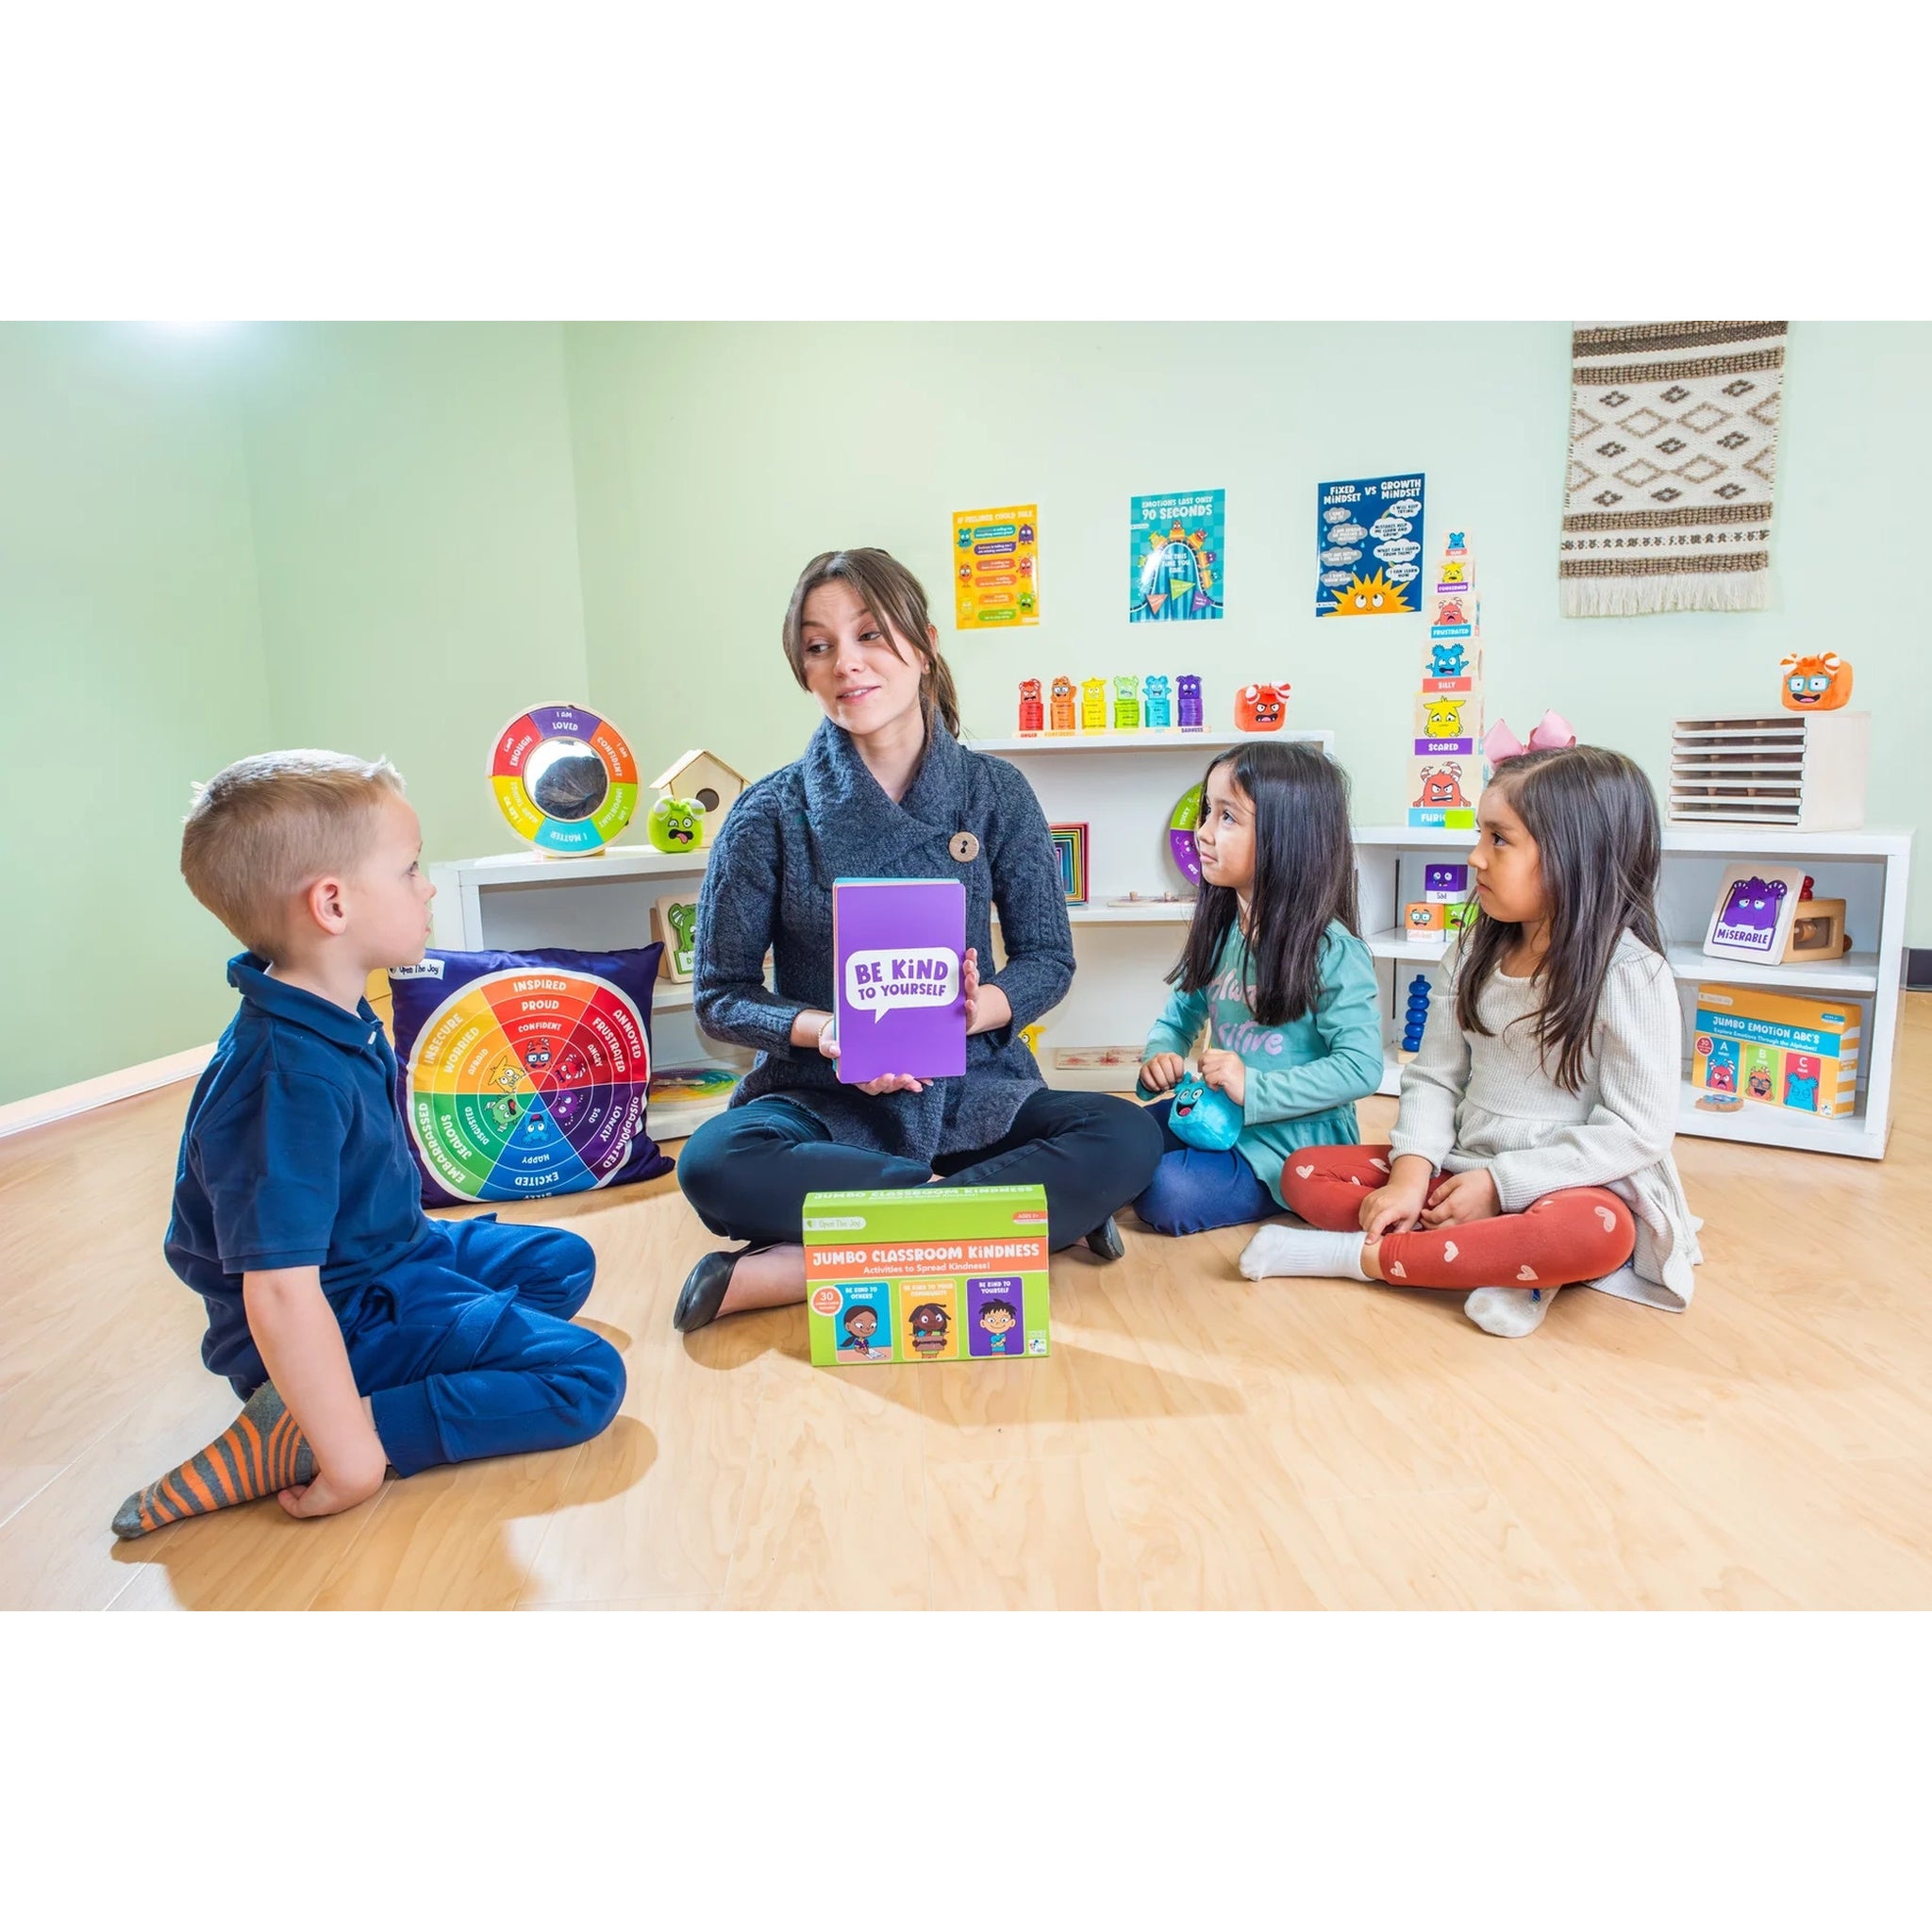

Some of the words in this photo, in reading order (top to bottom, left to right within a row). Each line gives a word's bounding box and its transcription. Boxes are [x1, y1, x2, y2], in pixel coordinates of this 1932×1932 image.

[1364, 487, 1376, 495] VS
[1381, 479, 1421, 491] GROWTH
[1142, 509, 1157, 520] 90
[1159, 504, 1213, 520] SECONDS
[1433, 627, 1469, 636] FRUSTRATED
[552, 722, 578, 731] LOVED
[509, 735, 533, 767] ENOUGH
[1428, 743, 1458, 752] SCARED
[596, 736, 623, 777] CONFIDENT
[599, 788, 623, 828] IMPORTANT
[550, 831, 582, 842] MATTER
[427, 964, 439, 975] Joy
[855, 961, 883, 985] BE
[891, 958, 948, 981] KiND
[512, 979, 567, 992] INSPIRED
[858, 987, 876, 1001] TO
[880, 983, 946, 997] YOURSELF
[521, 1000, 559, 1012] PROUD
[517, 1022, 562, 1033] CONFIDENT
[613, 1008, 641, 1059] ANNOYED
[1712, 1016, 1745, 1029] JUMBO
[1793, 1031, 1820, 1044] ABC'S
[425, 1012, 464, 1065] INSECURE
[591, 1017, 625, 1074] FRUSTRATED
[1720, 1041, 1728, 1051] A
[443, 1026, 480, 1074] WORRIED
[587, 1043, 604, 1068] ANGRY
[1758, 1048, 1767, 1058] B
[467, 1048, 489, 1076] AFRAID
[1799, 1057, 1808, 1068] C
[588, 1108, 601, 1124] SAD
[464, 1106, 490, 1146] DISGUSTED
[600, 1106, 624, 1143] LONELY
[602, 1095, 640, 1169] DISAPPOINTED
[418, 1102, 466, 1184] EMBARRASSED
[441, 1114, 472, 1161] JEALOUS
[521, 1154, 550, 1164] HAPPY
[514, 1171, 559, 1187] EXCITED
[813, 1250, 867, 1266] JUMBO
[872, 1246, 962, 1263] CLASSROOM
[863, 1265, 903, 1274] Activities
[916, 1263, 947, 1274] Spread
[949, 1262, 991, 1271] Kindness!
[821, 1291, 834, 1301] 30
